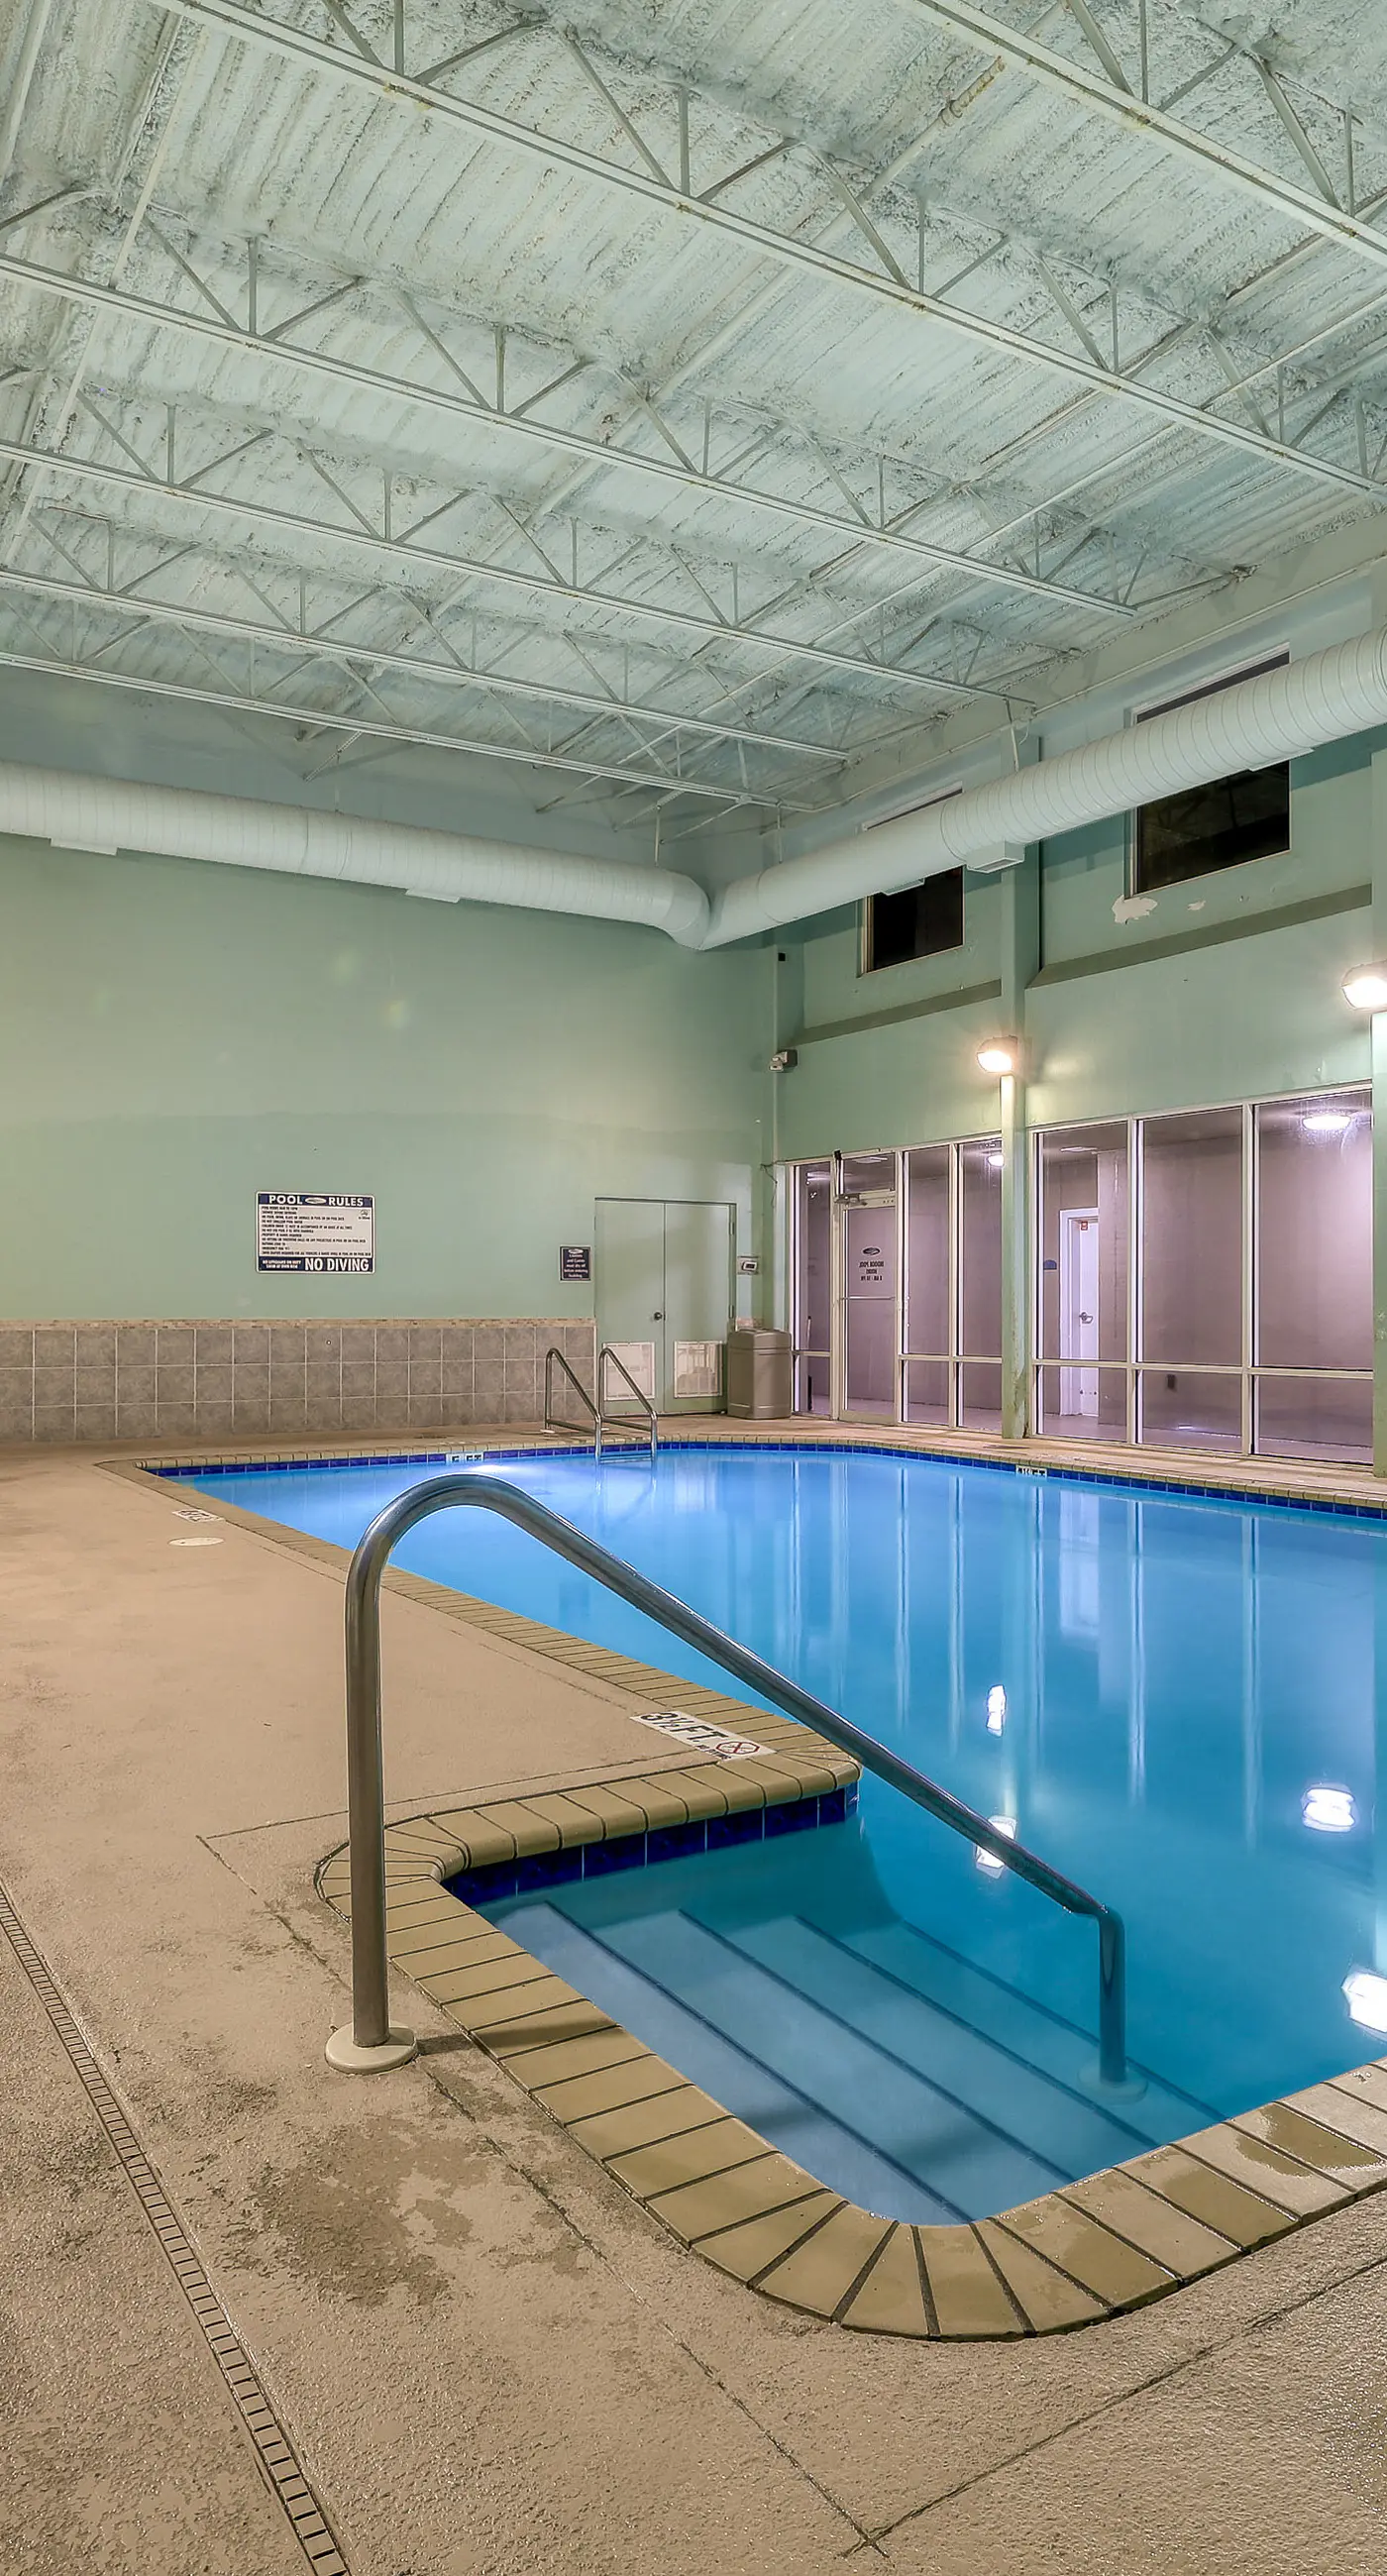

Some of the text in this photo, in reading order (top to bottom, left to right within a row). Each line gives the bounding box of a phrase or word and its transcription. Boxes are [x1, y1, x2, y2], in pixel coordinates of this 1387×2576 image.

[268, 1195, 303, 1205] POOL
[328, 1197, 364, 1207] RULES
[304, 1257, 370, 1272] NO DIVING
